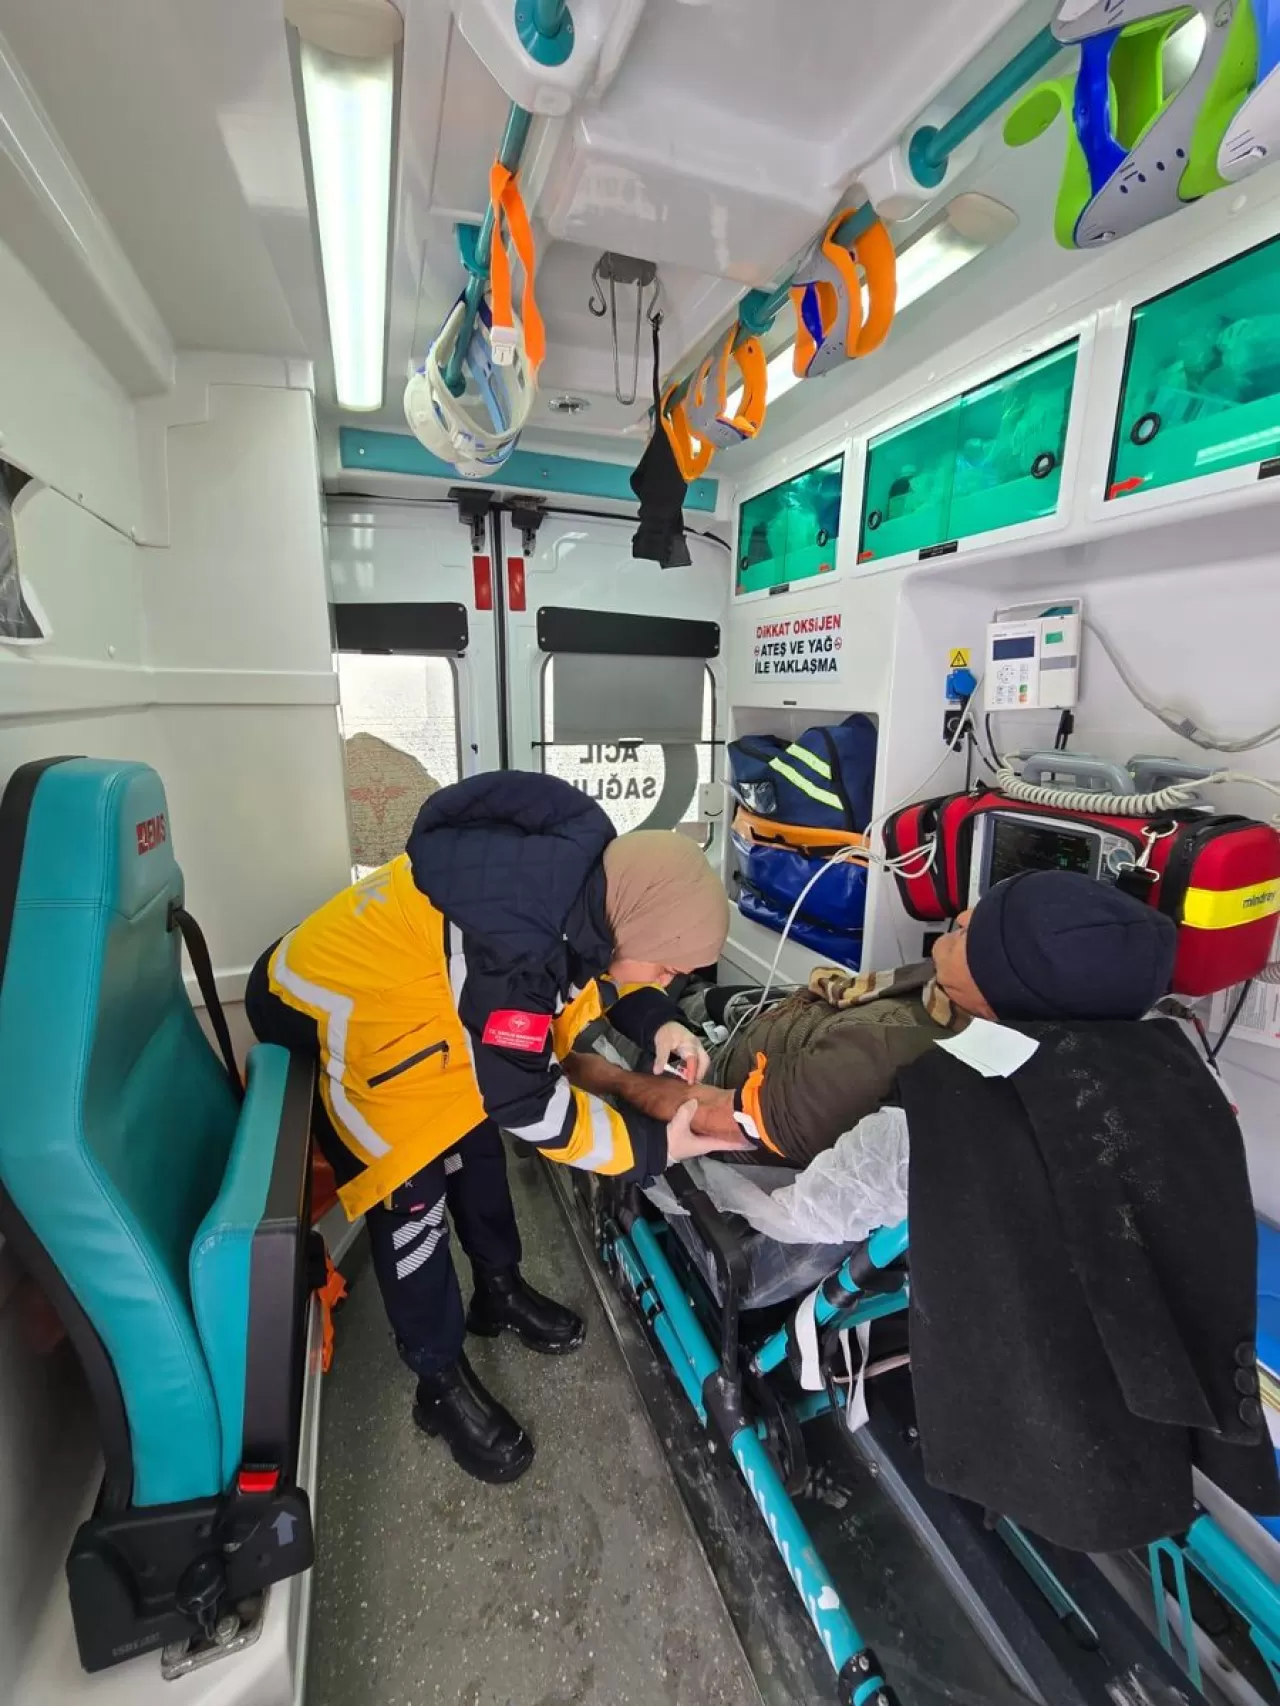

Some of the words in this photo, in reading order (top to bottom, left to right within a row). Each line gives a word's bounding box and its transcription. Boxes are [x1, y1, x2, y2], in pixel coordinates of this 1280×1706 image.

[761, 642, 787, 657] ATEŞ
[790, 640, 804, 655] VE
[808, 635, 833, 654] YAĞ
[773, 657, 837, 675] YAKLAŞMA
